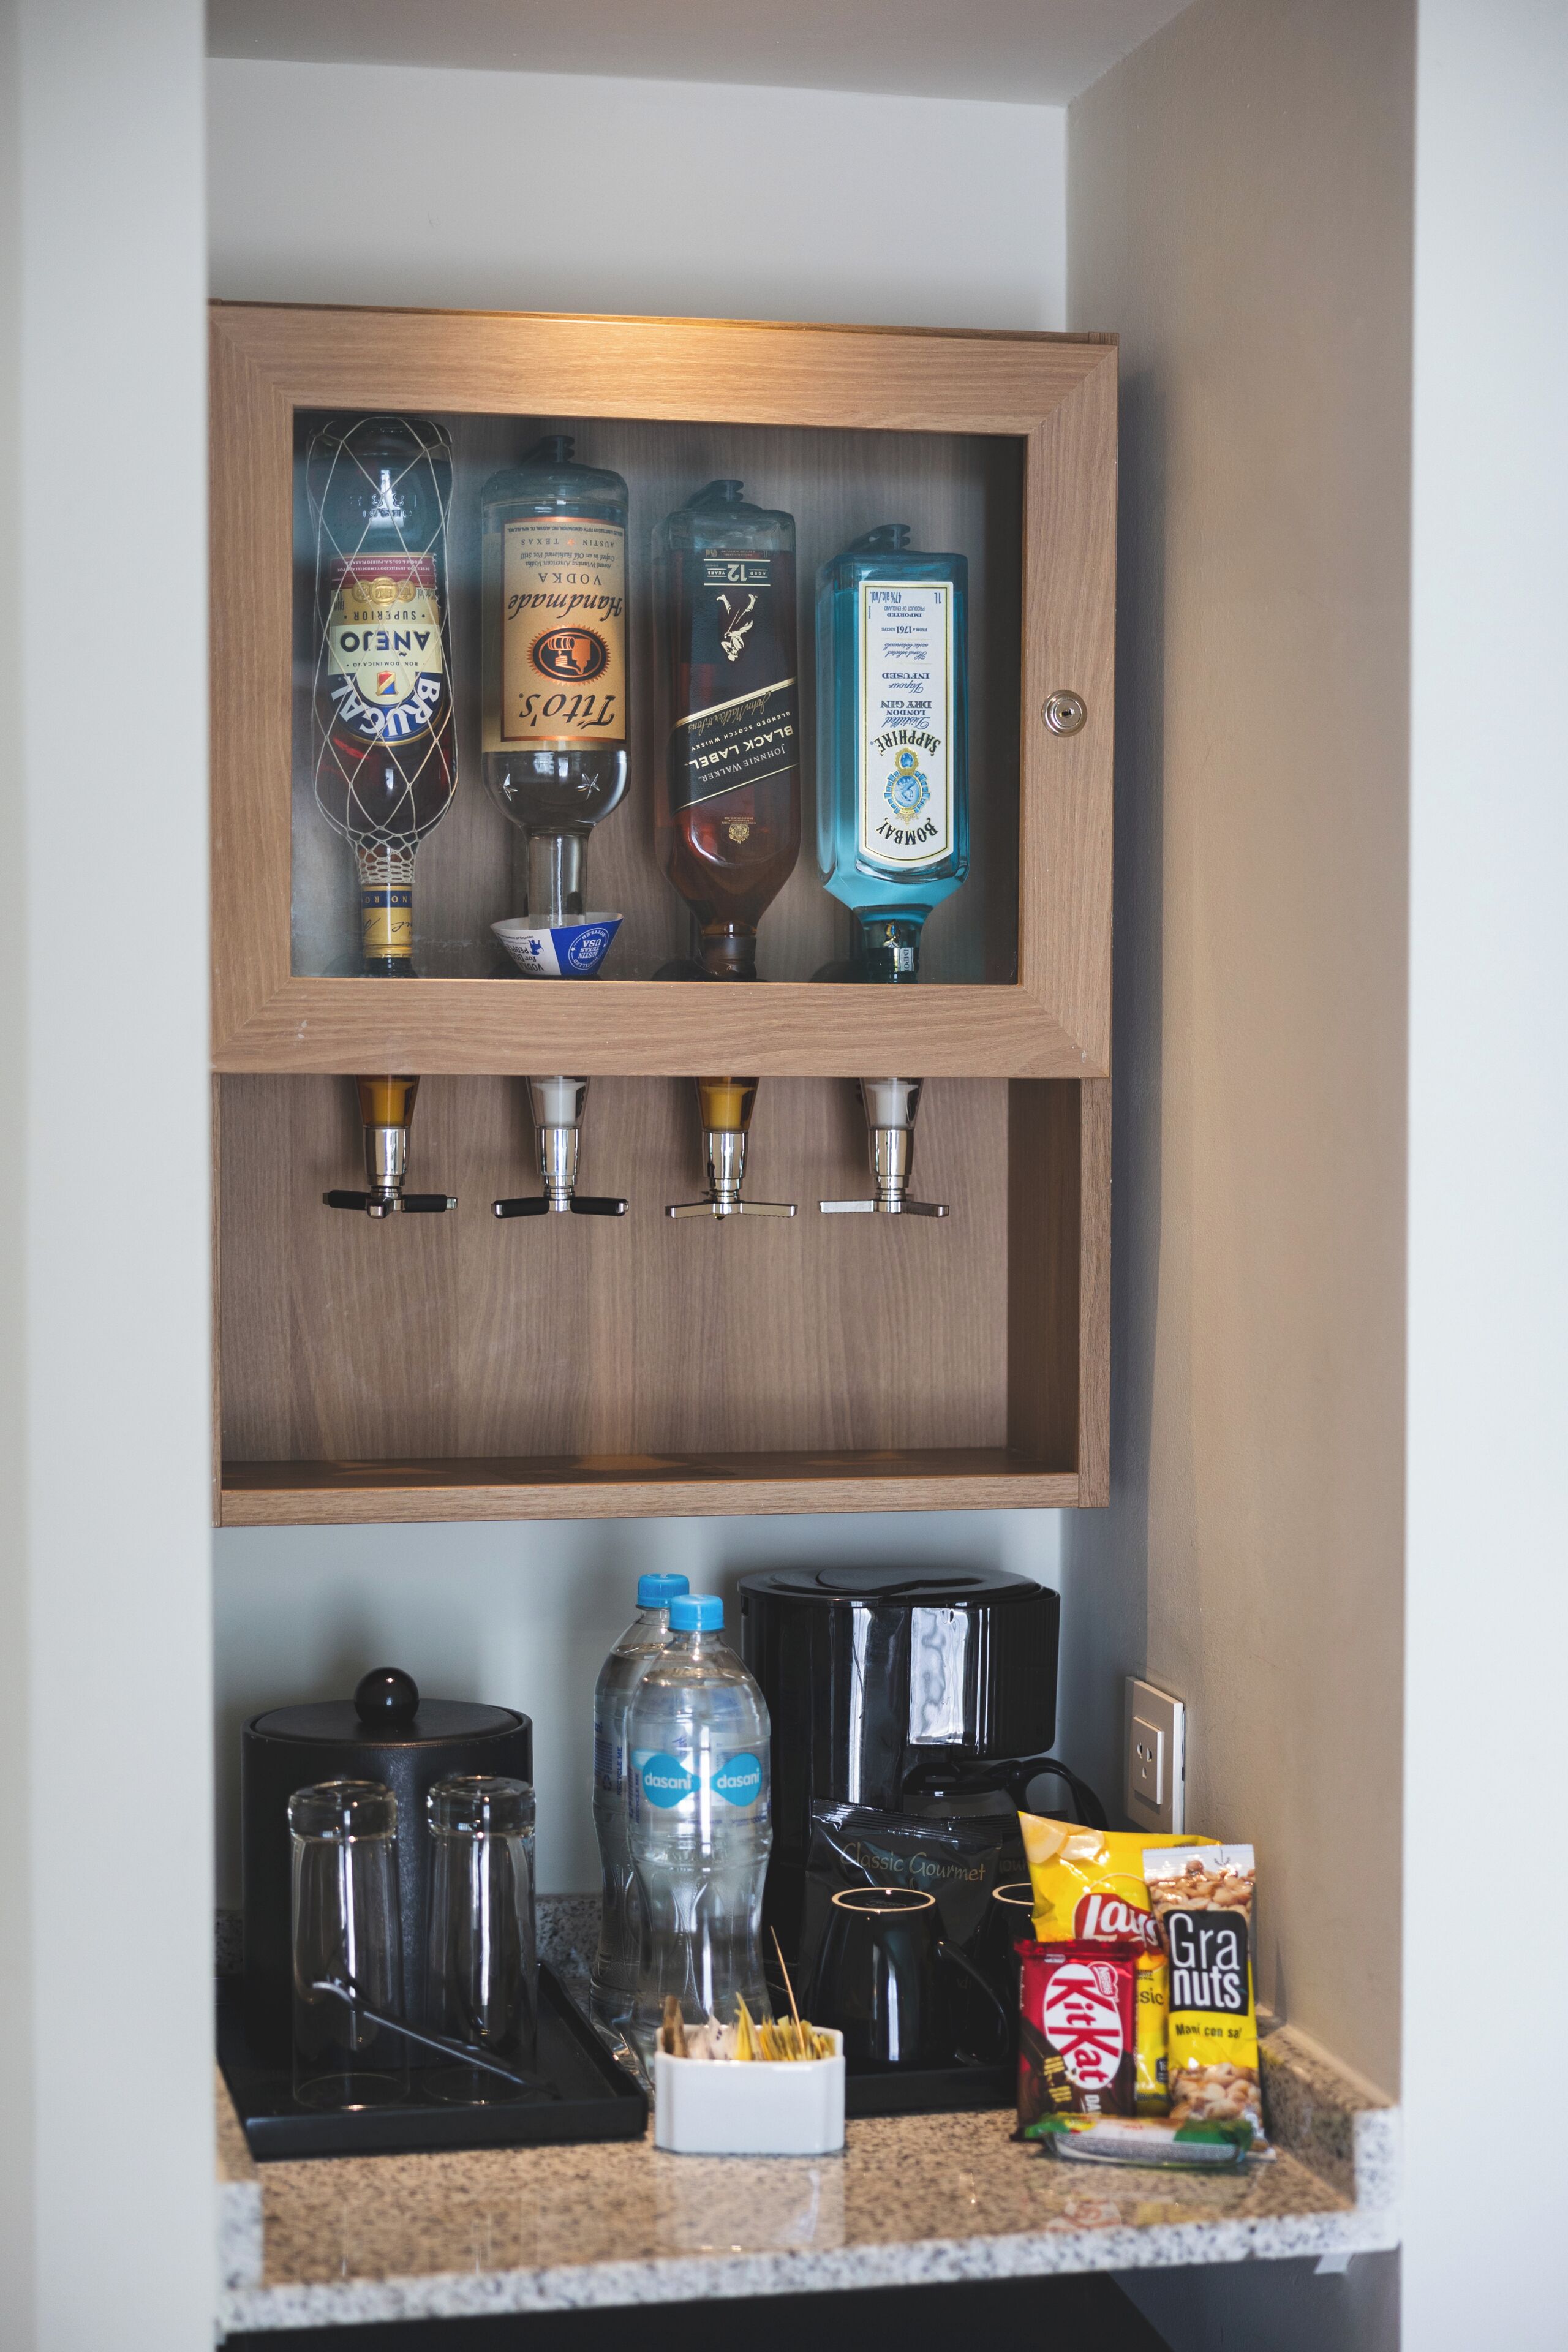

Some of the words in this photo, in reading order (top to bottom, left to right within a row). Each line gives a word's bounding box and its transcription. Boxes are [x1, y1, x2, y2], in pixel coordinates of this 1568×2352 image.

[582, 539, 614, 548] AUSTIN
[572, 559, 597, 568] Winning
[575, 552, 584, 561] Old
[600, 553, 615, 562] Crafted
[538, 573, 602, 586] VODKA
[727, 564, 748, 582] 12
[870, 591, 890, 603] alc./vol.
[890, 591, 902, 604] 47%
[508, 594, 622, 622] Handmade
[353, 611, 416, 621] SUPERIOR
[895, 625, 912, 634] 1761
[340, 631, 431, 657] AÑEJO
[883, 643, 913, 651] botanicals
[884, 650, 908, 659] selected
[906, 650, 927, 660] Hand
[888, 680, 924, 694] Vapour
[331, 676, 441, 737] BRUGAL
[519, 693, 616, 730] Tito's
[880, 700, 905, 709] GIN
[756, 711, 790, 727] BLENDED
[881, 716, 930, 730] Distilled
[723, 725, 753, 739] SCOTCH
[742, 725, 794, 752] BLACK
[691, 737, 720, 752] WHISKY
[874, 729, 941, 756] SAPPHIRE
[688, 745, 740, 769] LABEL
[742, 744, 785, 767] JOHNNIE
[701, 763, 742, 782] WALKER
[876, 817, 938, 845] BOMBAY
[583, 938, 601, 947] USA
[617, 1746, 622, 1760] ME
[644, 1772, 692, 1790] dasani
[717, 1767, 760, 1789] dasani
[840, 1842, 904, 1872] Classic
[909, 1852, 986, 1881] Gourmet
[1169, 1913, 1240, 1970] Gra
[1174, 1966, 1241, 2009] nuts
[1204, 2027, 1223, 2038] con
[1227, 2027, 1242, 2039] sal
